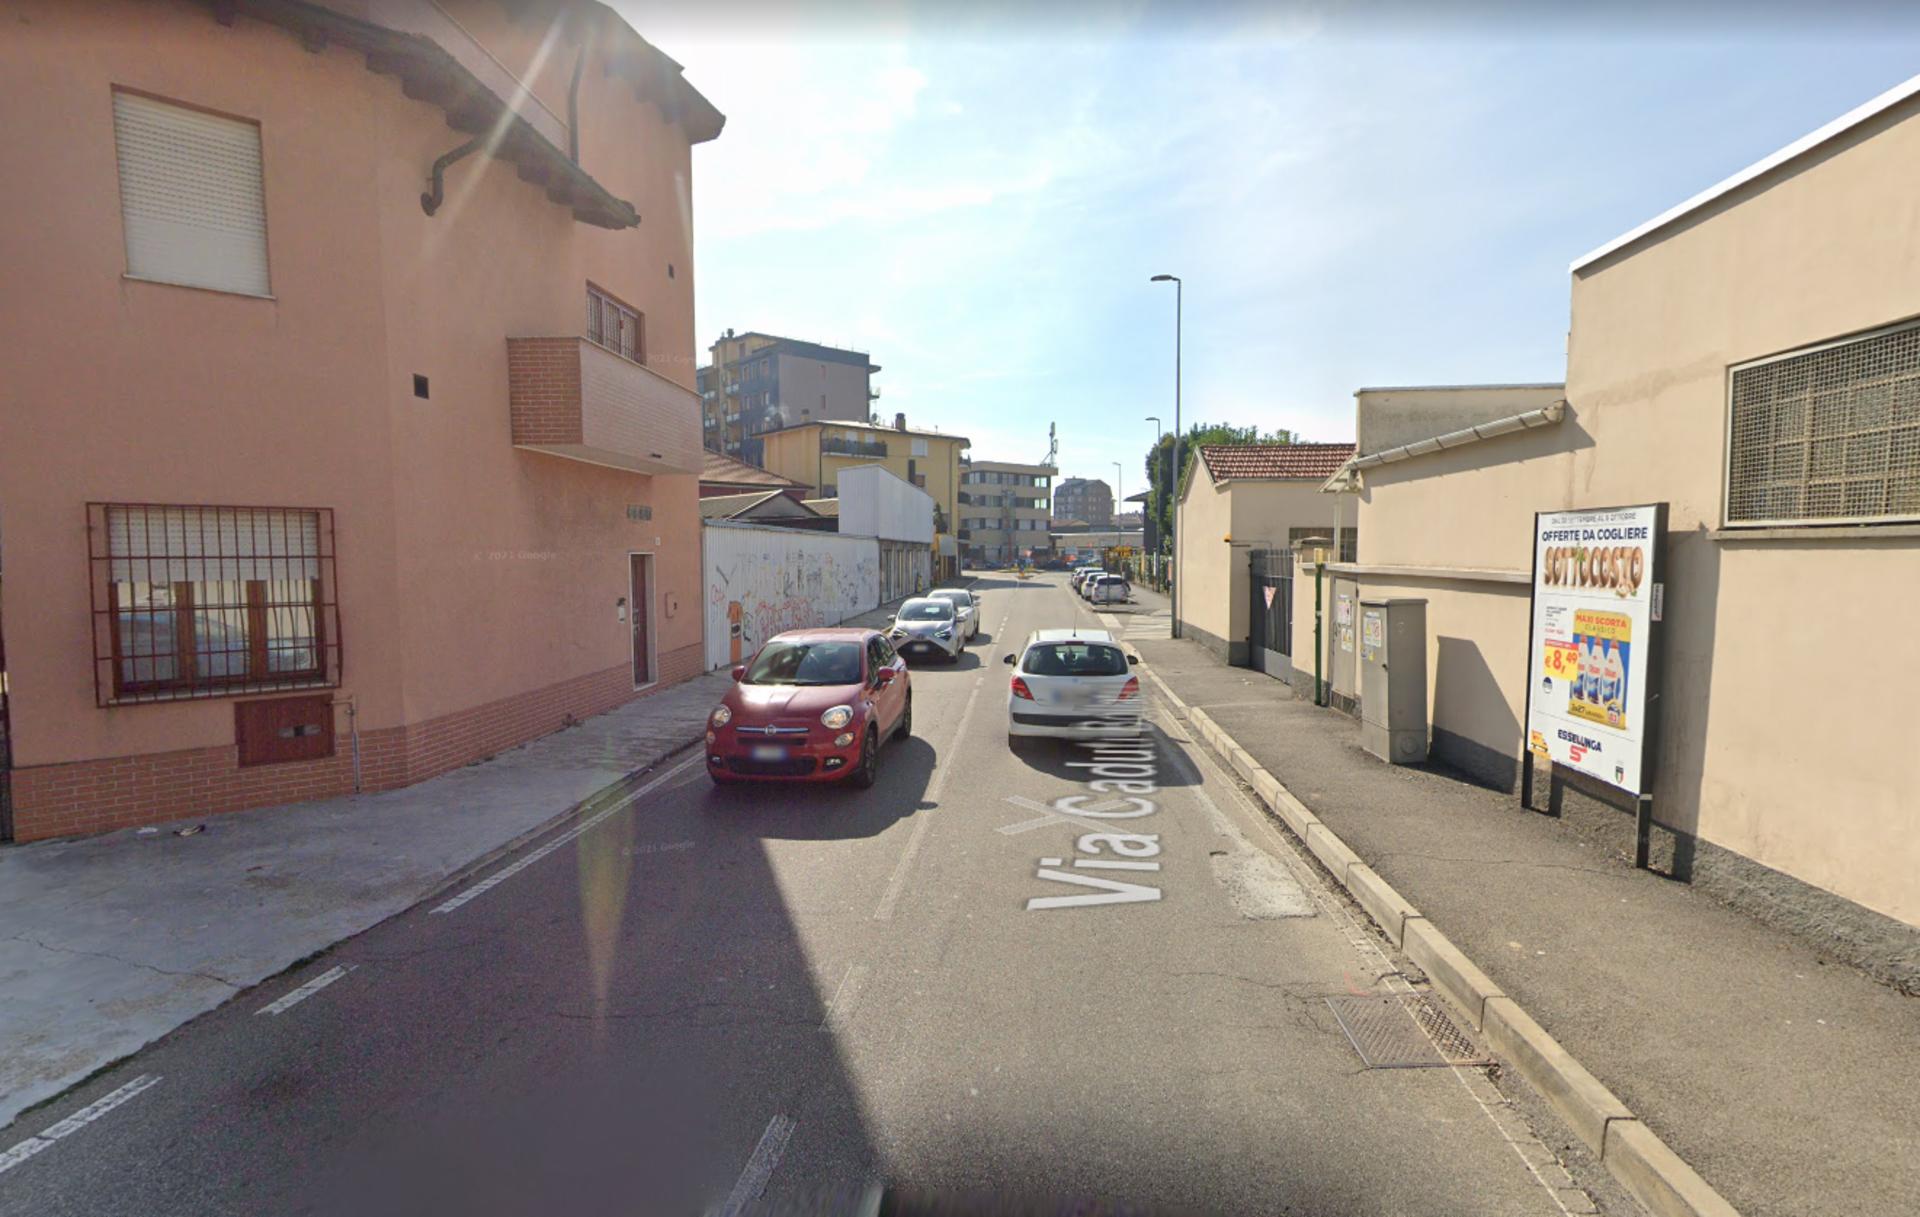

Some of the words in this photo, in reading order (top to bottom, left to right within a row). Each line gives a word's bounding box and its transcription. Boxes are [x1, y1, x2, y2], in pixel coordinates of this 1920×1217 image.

[1542, 530, 1581, 541] OFFERTE
[1582, 529, 1596, 540] DA
[1597, 527, 1648, 540] COGLIERE
[1544, 546, 1644, 590] SOTTOCOSTO
[1576, 614, 1595, 624] MAXI
[1595, 616, 1627, 628] SCORTA
[1558, 728, 1602, 753] ESSELUNGA
